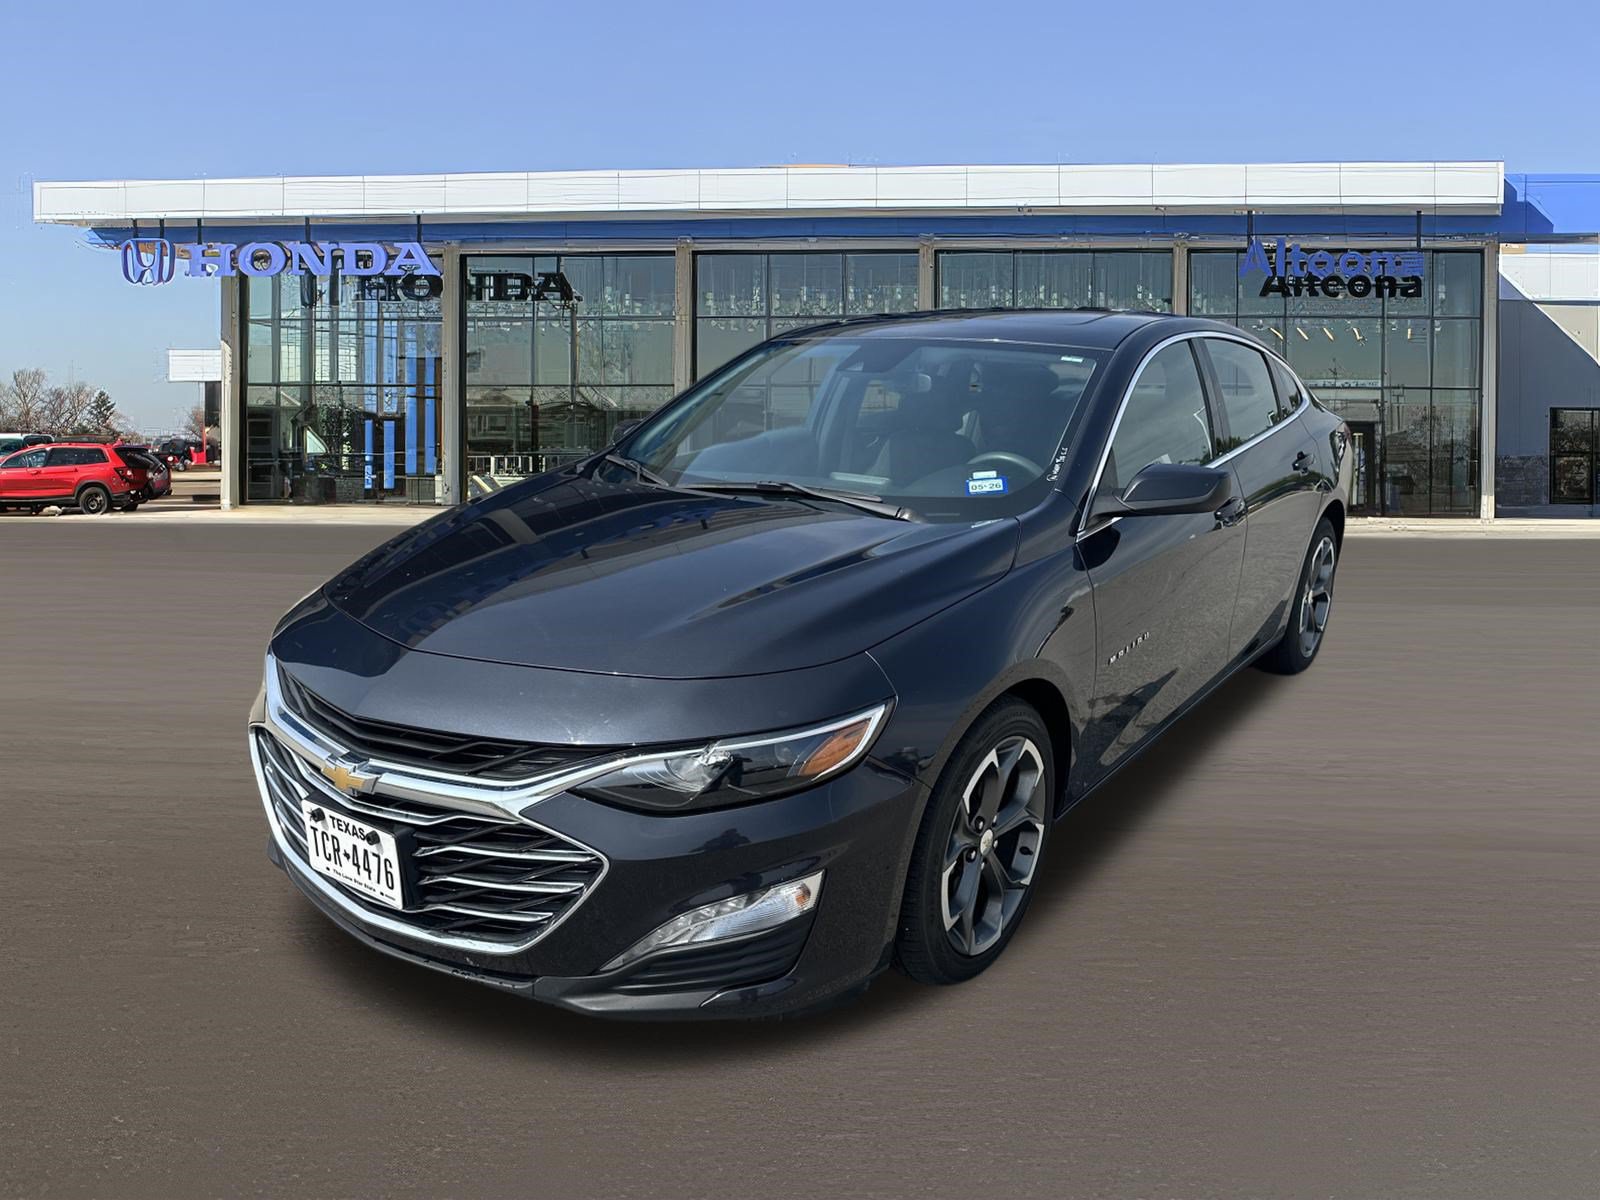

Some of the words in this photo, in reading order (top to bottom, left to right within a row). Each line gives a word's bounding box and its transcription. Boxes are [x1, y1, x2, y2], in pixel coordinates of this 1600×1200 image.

[185, 241, 441, 277] HONDA
[1238, 235, 1425, 277] Altoon
[329, 815, 367, 841] TEXAS
